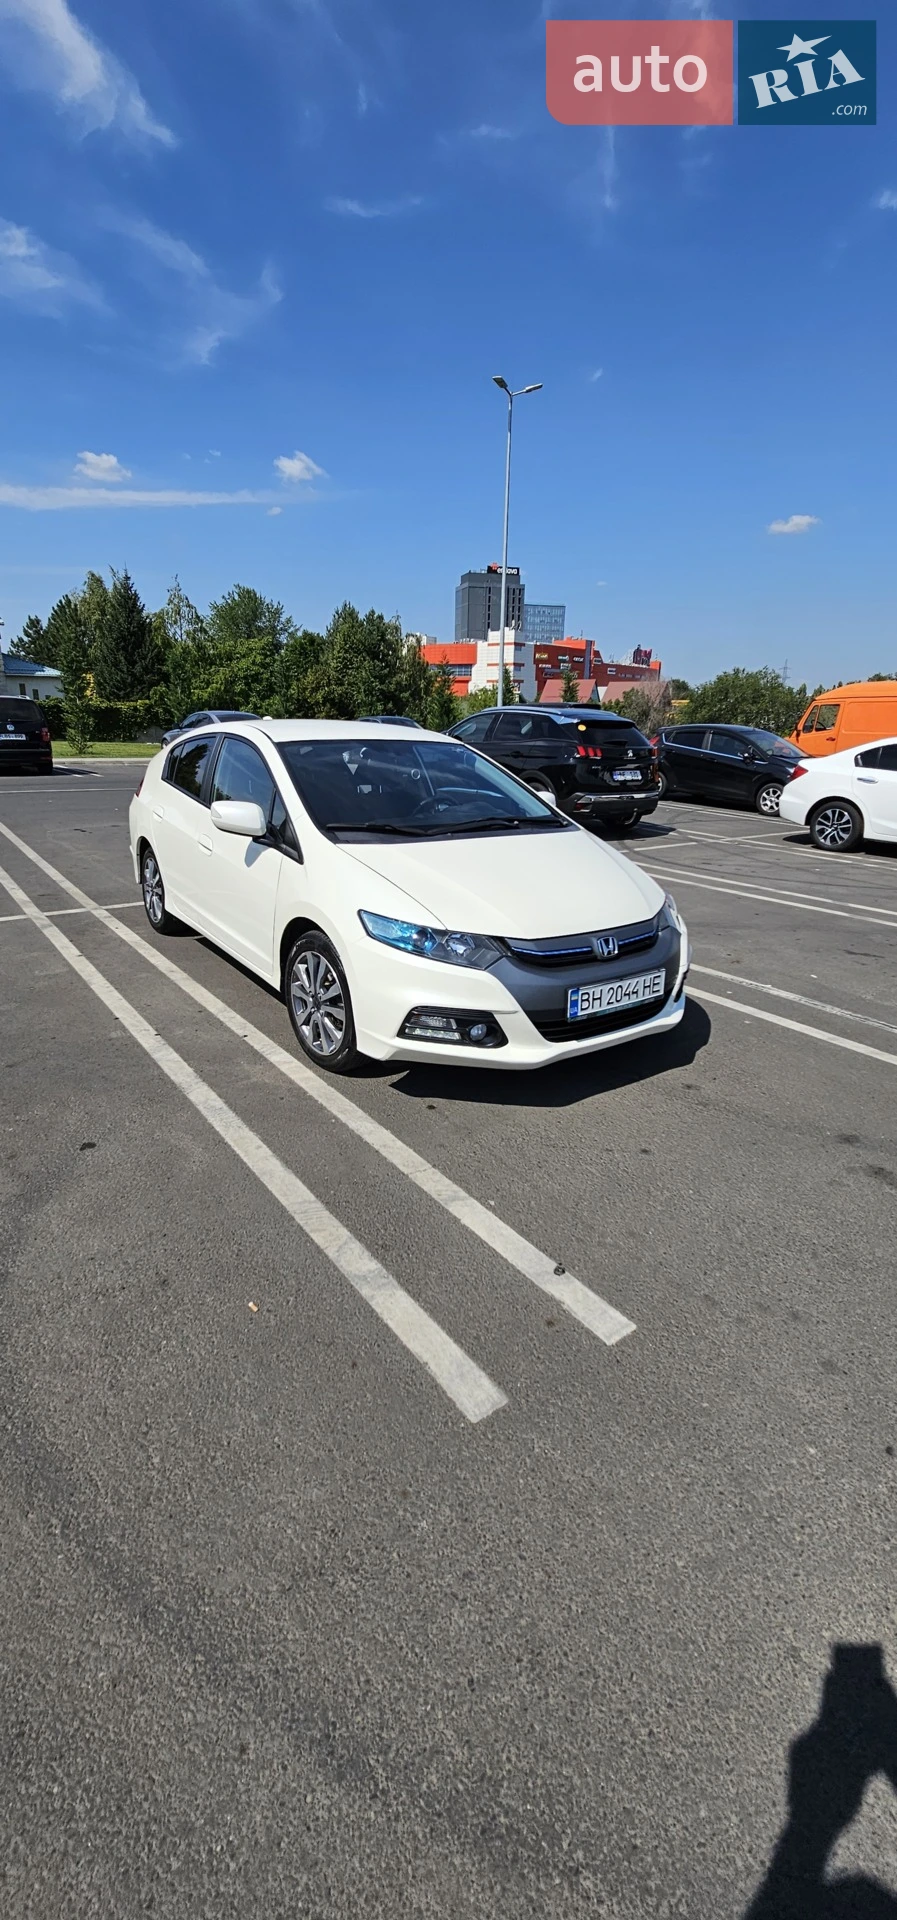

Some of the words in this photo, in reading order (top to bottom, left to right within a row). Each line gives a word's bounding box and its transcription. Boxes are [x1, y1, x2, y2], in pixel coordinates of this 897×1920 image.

[581, 989, 602, 1011] BH
[607, 980, 638, 1005] 2044
[642, 975, 661, 996] HE
